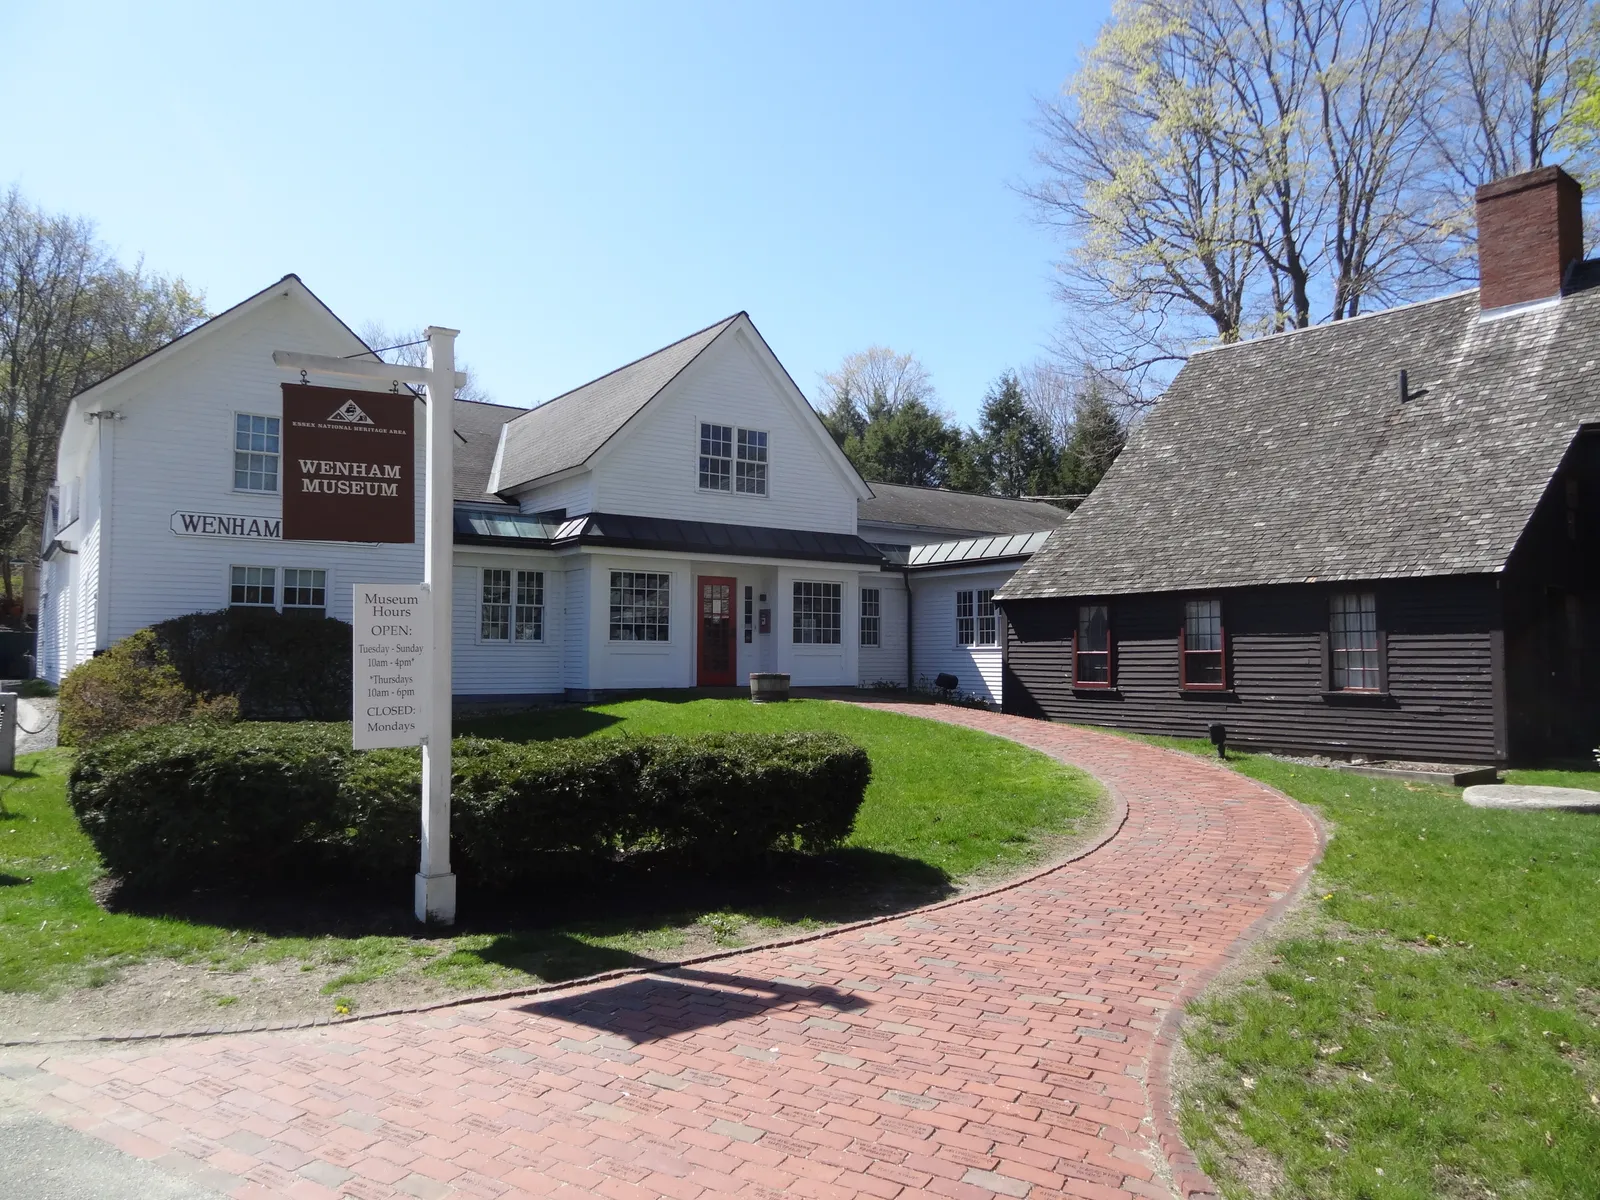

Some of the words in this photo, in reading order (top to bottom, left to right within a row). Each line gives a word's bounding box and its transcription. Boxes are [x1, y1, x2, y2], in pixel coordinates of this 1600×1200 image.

[317, 423, 353, 431] NATIONAL
[298, 459, 401, 479] WENHAM
[301, 478, 398, 497] MUSEUM
[180, 514, 281, 538] WENHAM
[365, 593, 418, 604] Museum
[372, 605, 411, 617] Hours
[371, 625, 412, 636] OPEN:
[358, 644, 390, 656] Tuesday
[396, 643, 424, 655] Sunday
[368, 658, 388, 667] 10am
[367, 688, 389, 697] 10am
[396, 688, 415, 699] 6pm
[366, 705, 416, 717] CLOSED:
[367, 721, 415, 733] Mondays
